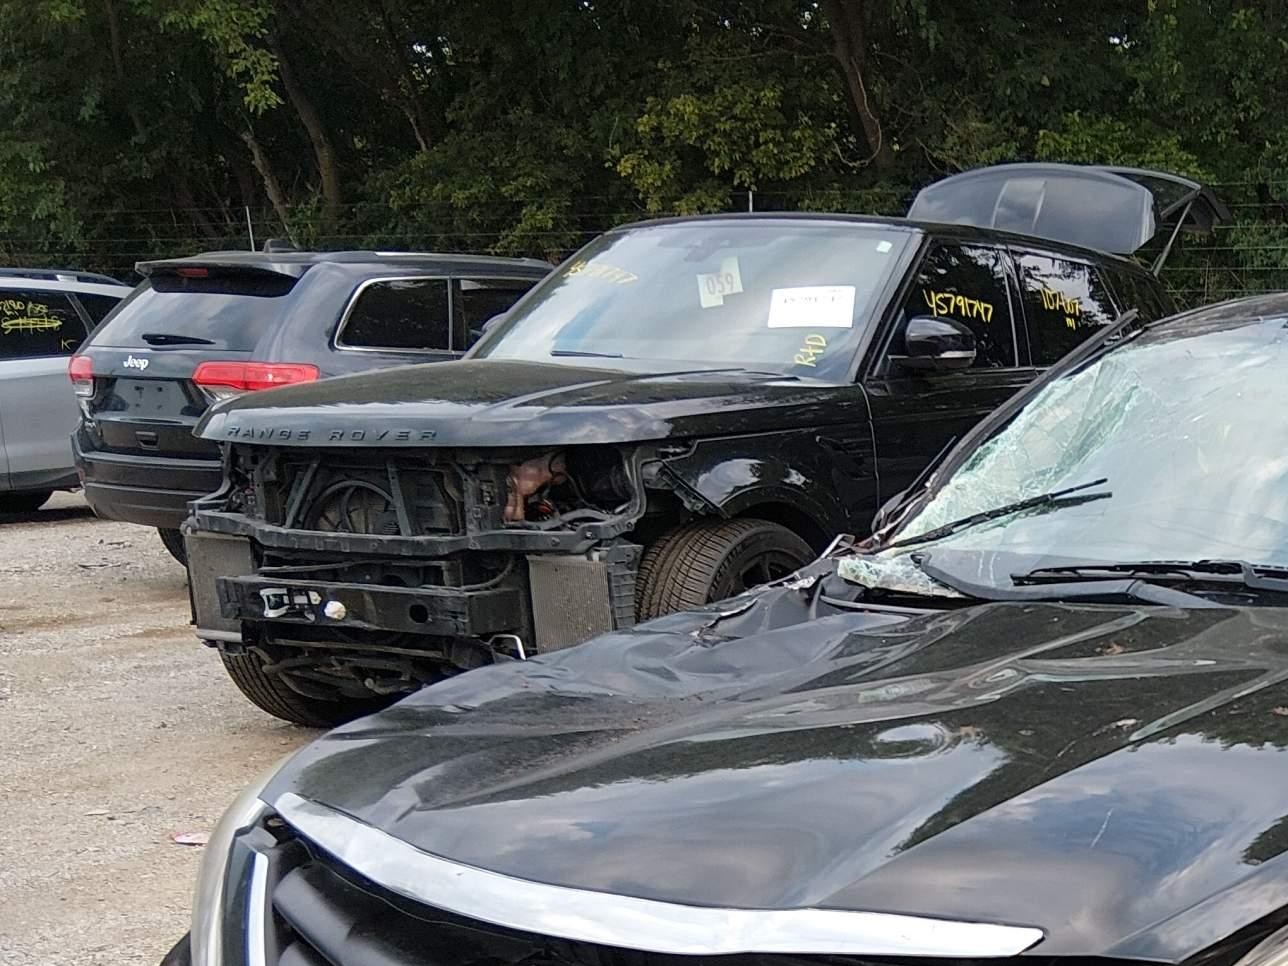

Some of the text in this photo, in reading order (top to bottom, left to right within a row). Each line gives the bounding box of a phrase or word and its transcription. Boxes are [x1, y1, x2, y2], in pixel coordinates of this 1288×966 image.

[123, 354, 149, 371] Jeep
[227, 427, 438, 442] RANGE ROVER
